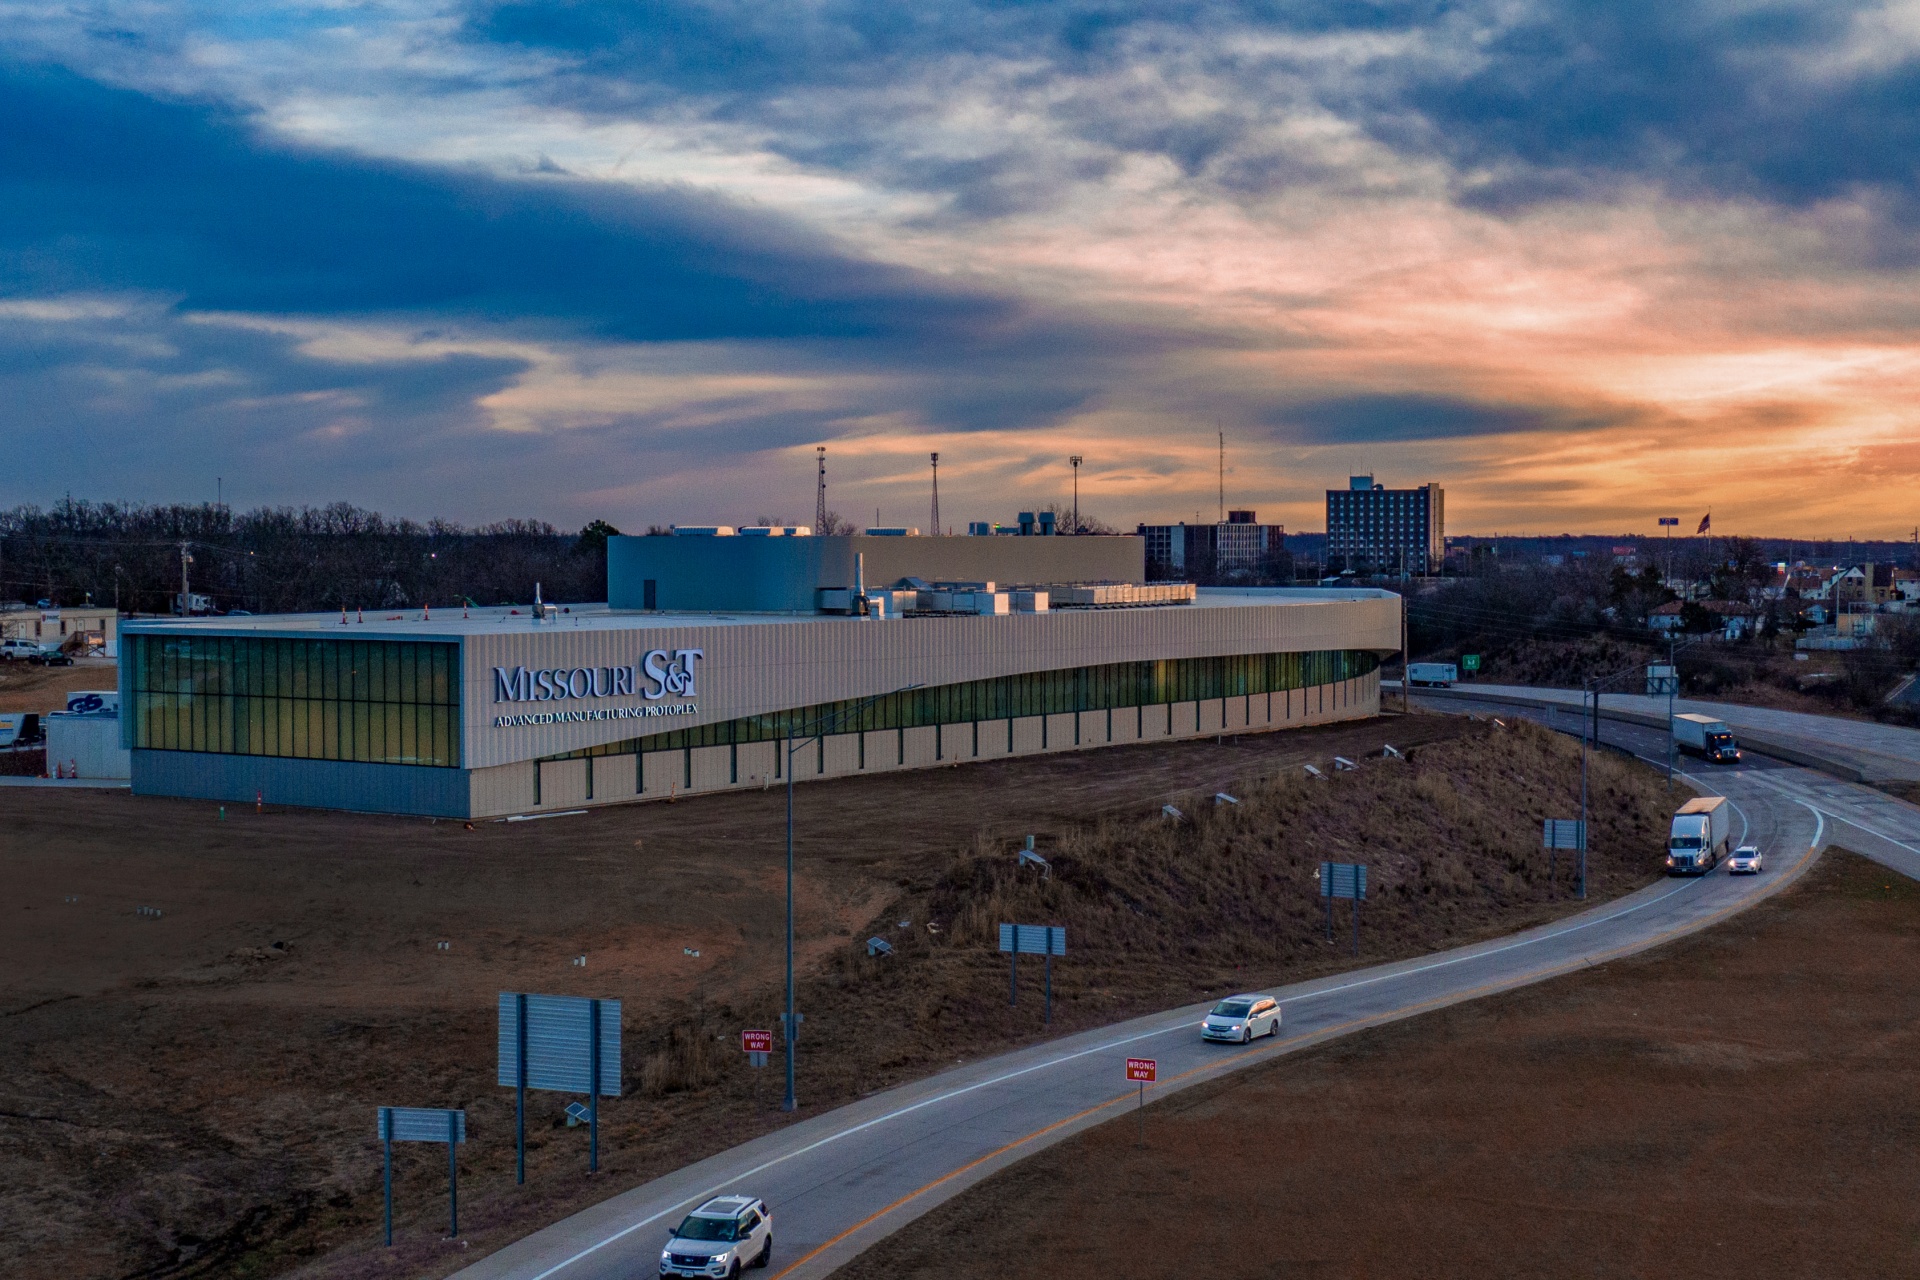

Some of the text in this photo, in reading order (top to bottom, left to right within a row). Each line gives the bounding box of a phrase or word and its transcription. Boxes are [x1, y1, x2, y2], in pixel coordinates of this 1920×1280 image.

[495, 648, 703, 702] MISSOURI S&T
[496, 703, 698, 727] ADVANCED MANUFACTURING PROTOPLEX
[1128, 1061, 1155, 1070] WRONG
[1133, 1070, 1149, 1078] WAY
